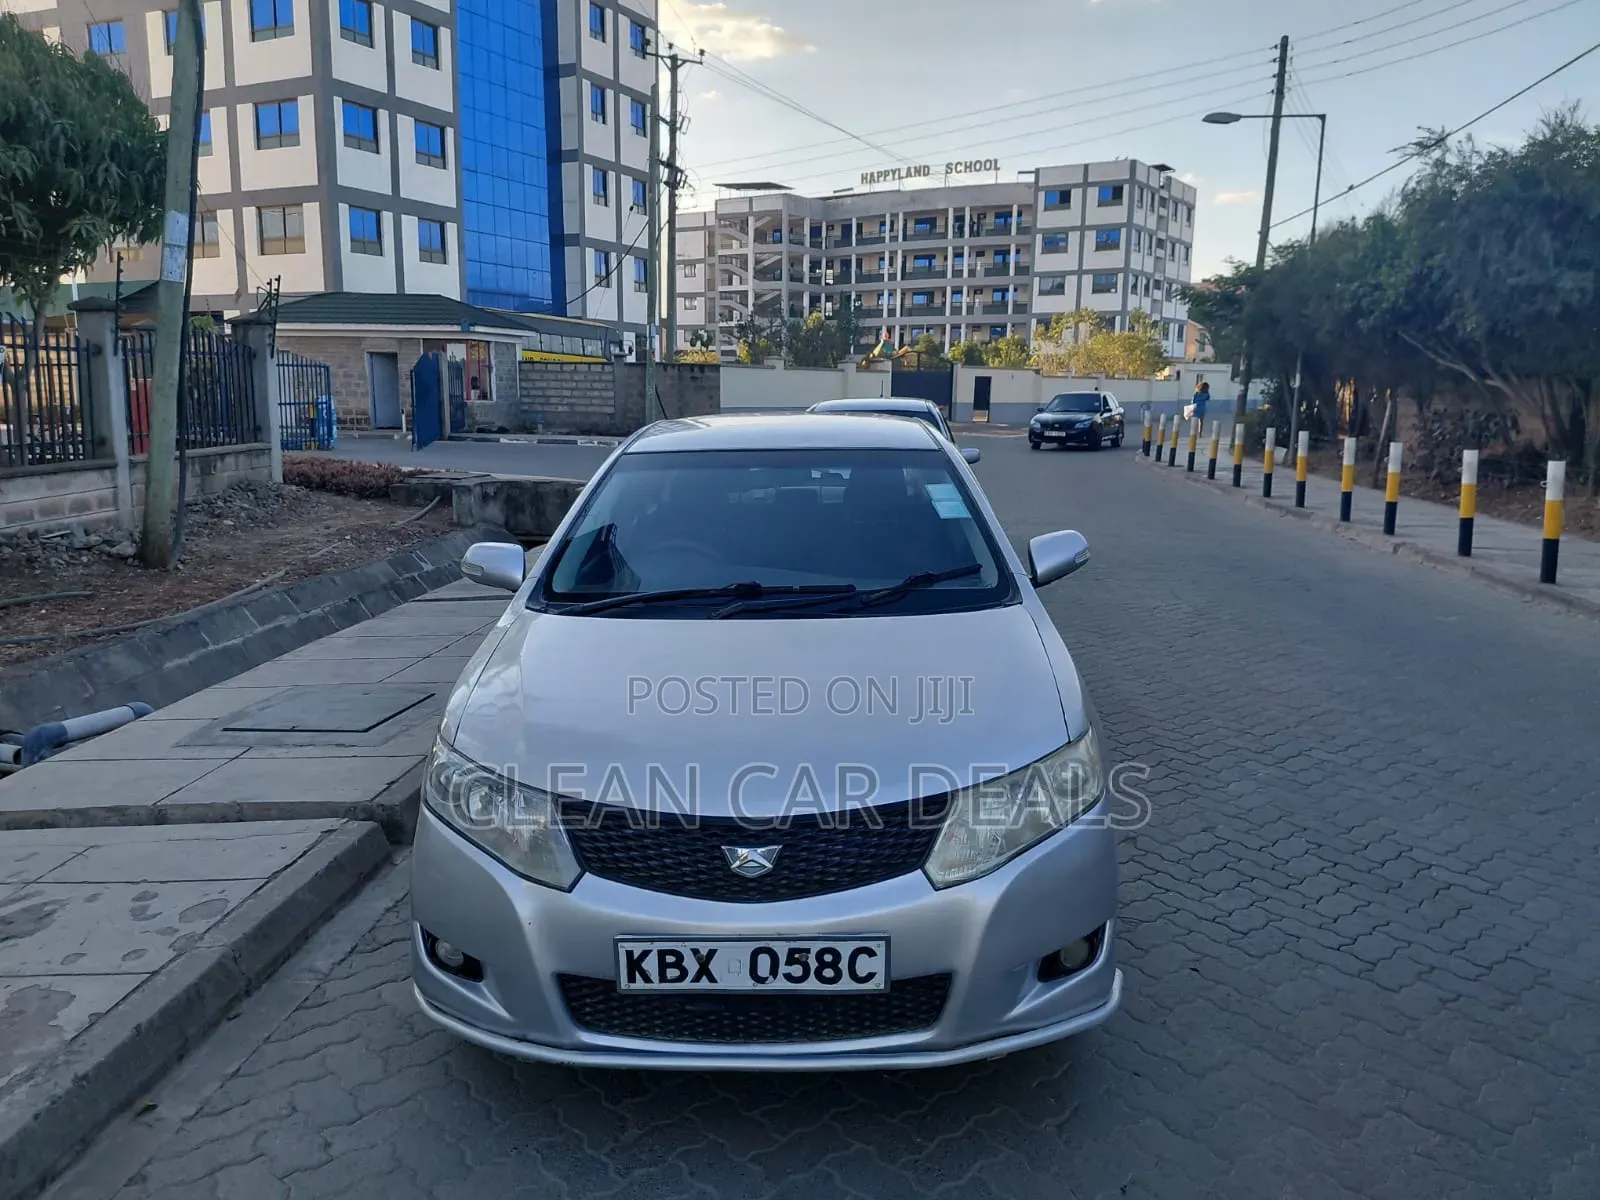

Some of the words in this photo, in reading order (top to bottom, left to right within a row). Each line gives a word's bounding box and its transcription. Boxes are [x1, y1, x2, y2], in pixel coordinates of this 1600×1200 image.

[860, 165, 930, 184] HAPPYLAND
[945, 158, 1000, 174] SCHOOL
[624, 948, 719, 984] KBX
[749, 946, 879, 986] 058C
